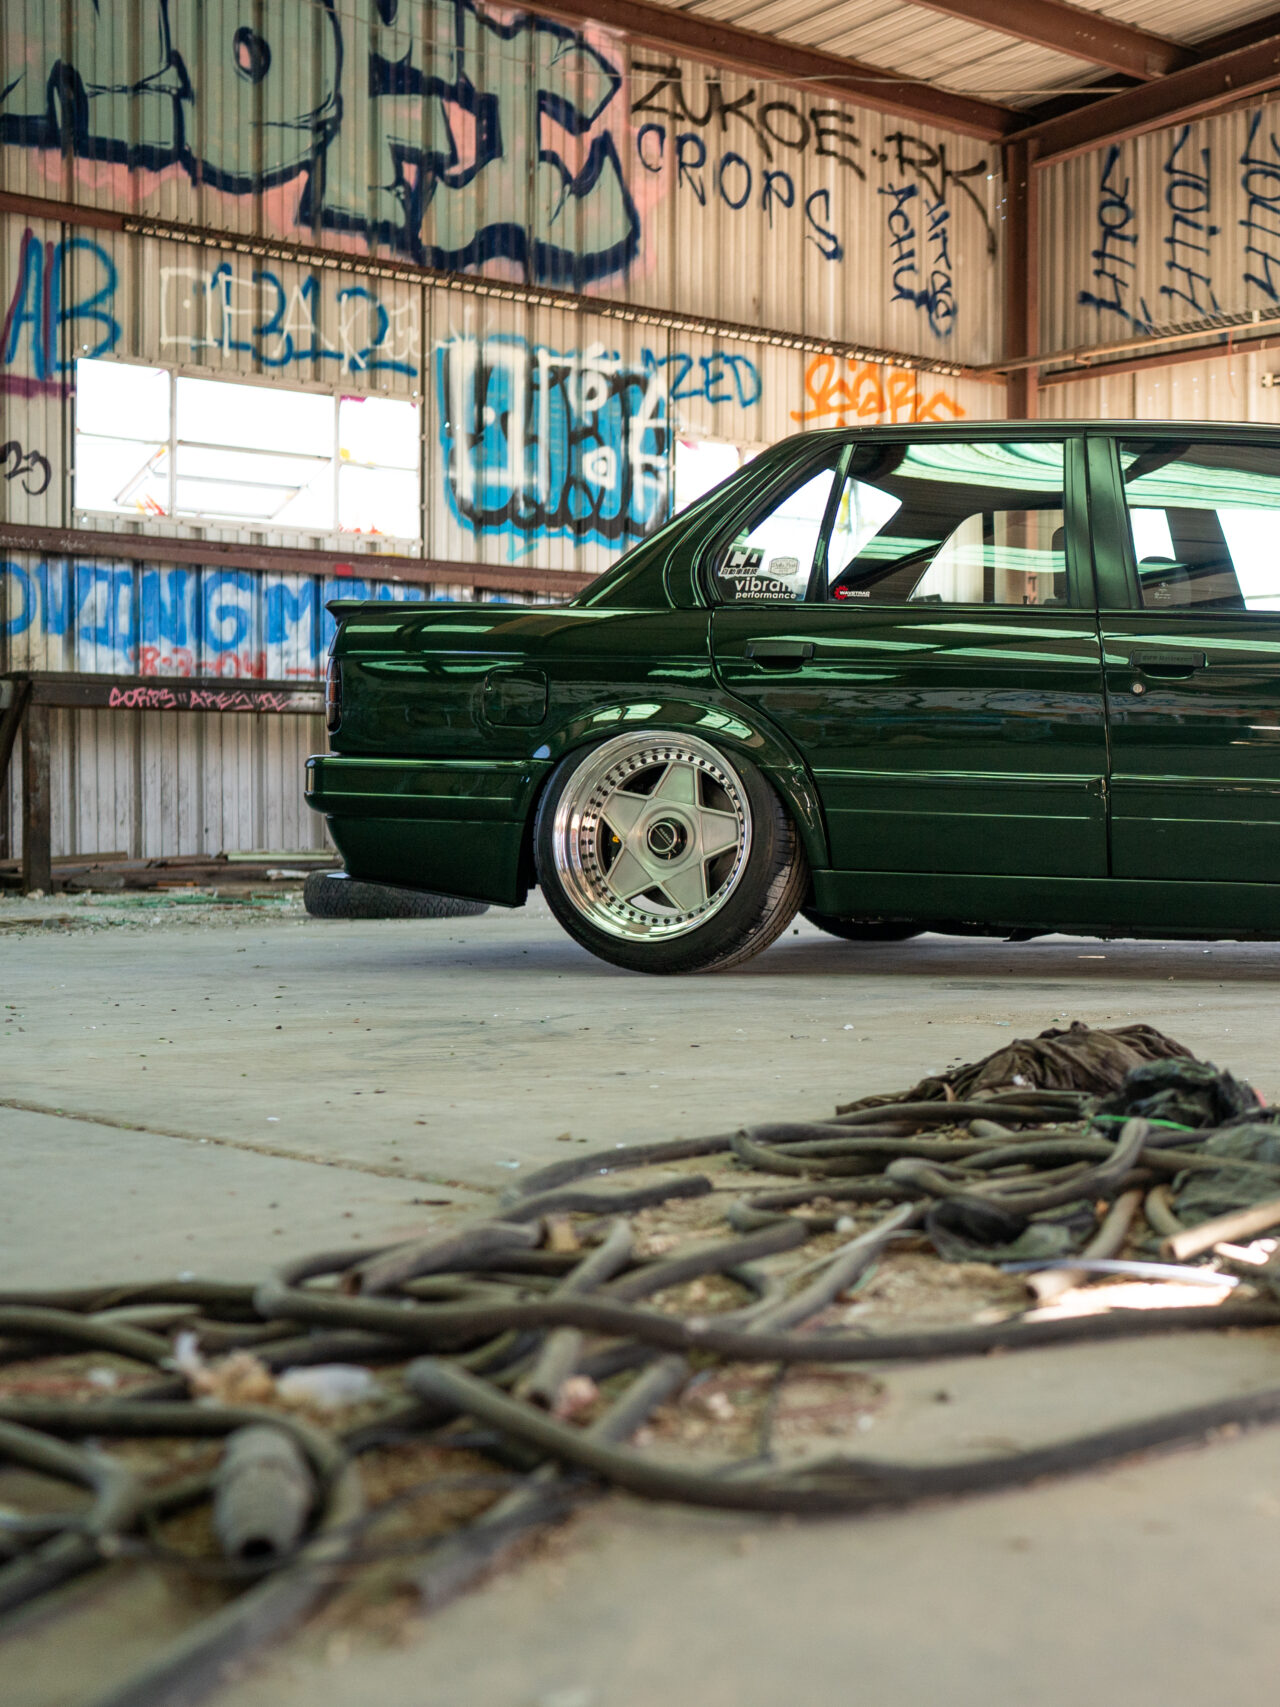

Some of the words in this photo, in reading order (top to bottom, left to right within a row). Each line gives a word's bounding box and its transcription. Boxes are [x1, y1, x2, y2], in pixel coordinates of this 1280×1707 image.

[637, 123, 843, 261] CROPS
[735, 577, 795, 591] vibran
[735, 591, 797, 600] performance
